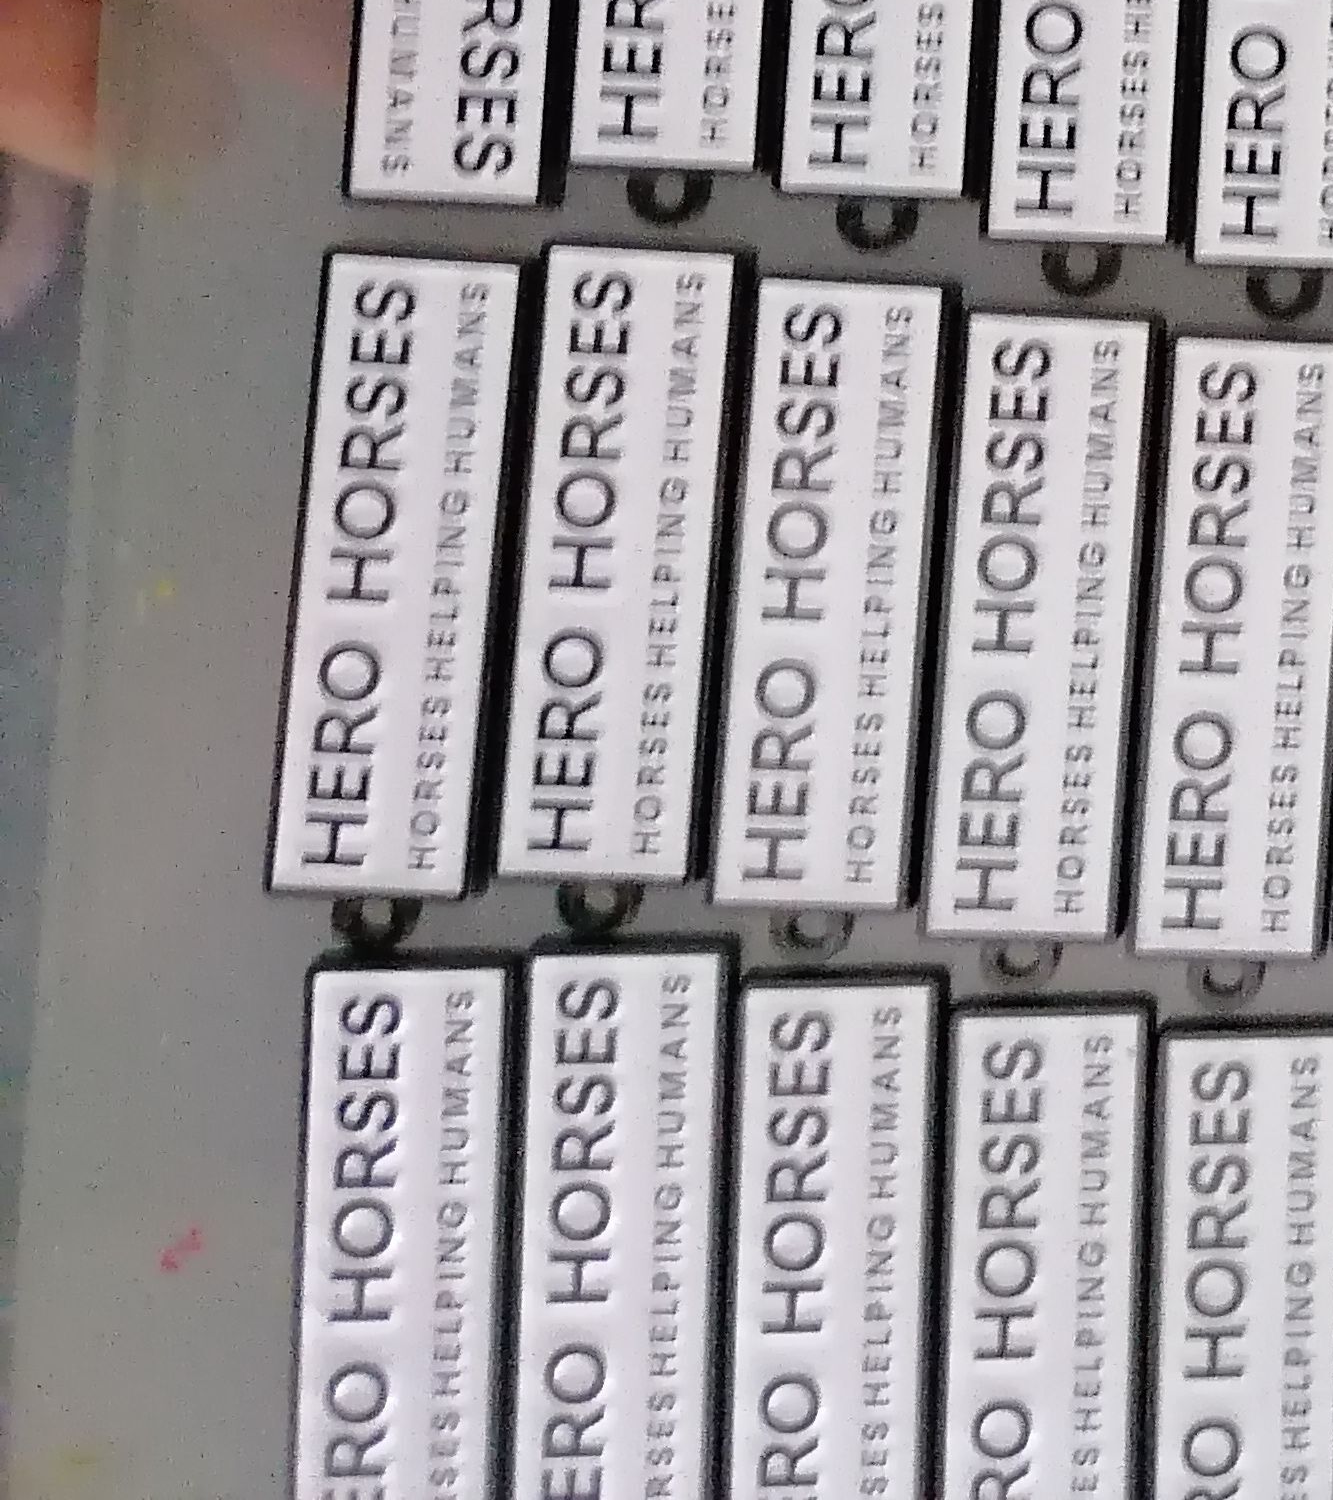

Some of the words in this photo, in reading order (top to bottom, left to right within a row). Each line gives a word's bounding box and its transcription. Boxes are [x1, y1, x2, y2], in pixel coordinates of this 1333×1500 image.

[324, 278, 419, 605] HORSES
[440, 281, 492, 478] HUMANS
[547, 269, 636, 591] HORSES
[659, 271, 707, 466] HUMANS
[1078, 339, 1123, 531] HUMANS
[421, 487, 472, 682] HELPING
[643, 475, 691, 668] HELPING
[971, 338, 1054, 656] HORSES
[1178, 361, 1260, 677] HORSES
[1064, 540, 1109, 730] HELPING
[299, 639, 385, 866] HERO
[403, 692, 453, 870] HORSES
[526, 625, 607, 851] HERO
[627, 678, 674, 855] HORSES
[953, 690, 1029, 910] HERO
[1051, 740, 1095, 913] HORSES
[1161, 710, 1236, 929] HERO
[326, 994, 402, 1325] HORSES
[435, 989, 476, 1187] HUMANS
[760, 1010, 832, 1333] HORSES
[865, 1005, 903, 1197] HUMANS
[427, 1200, 468, 1396] HELPING
[858, 1210, 897, 1402] HELPING
[1184, 1061, 1251, 1377] HORSES
